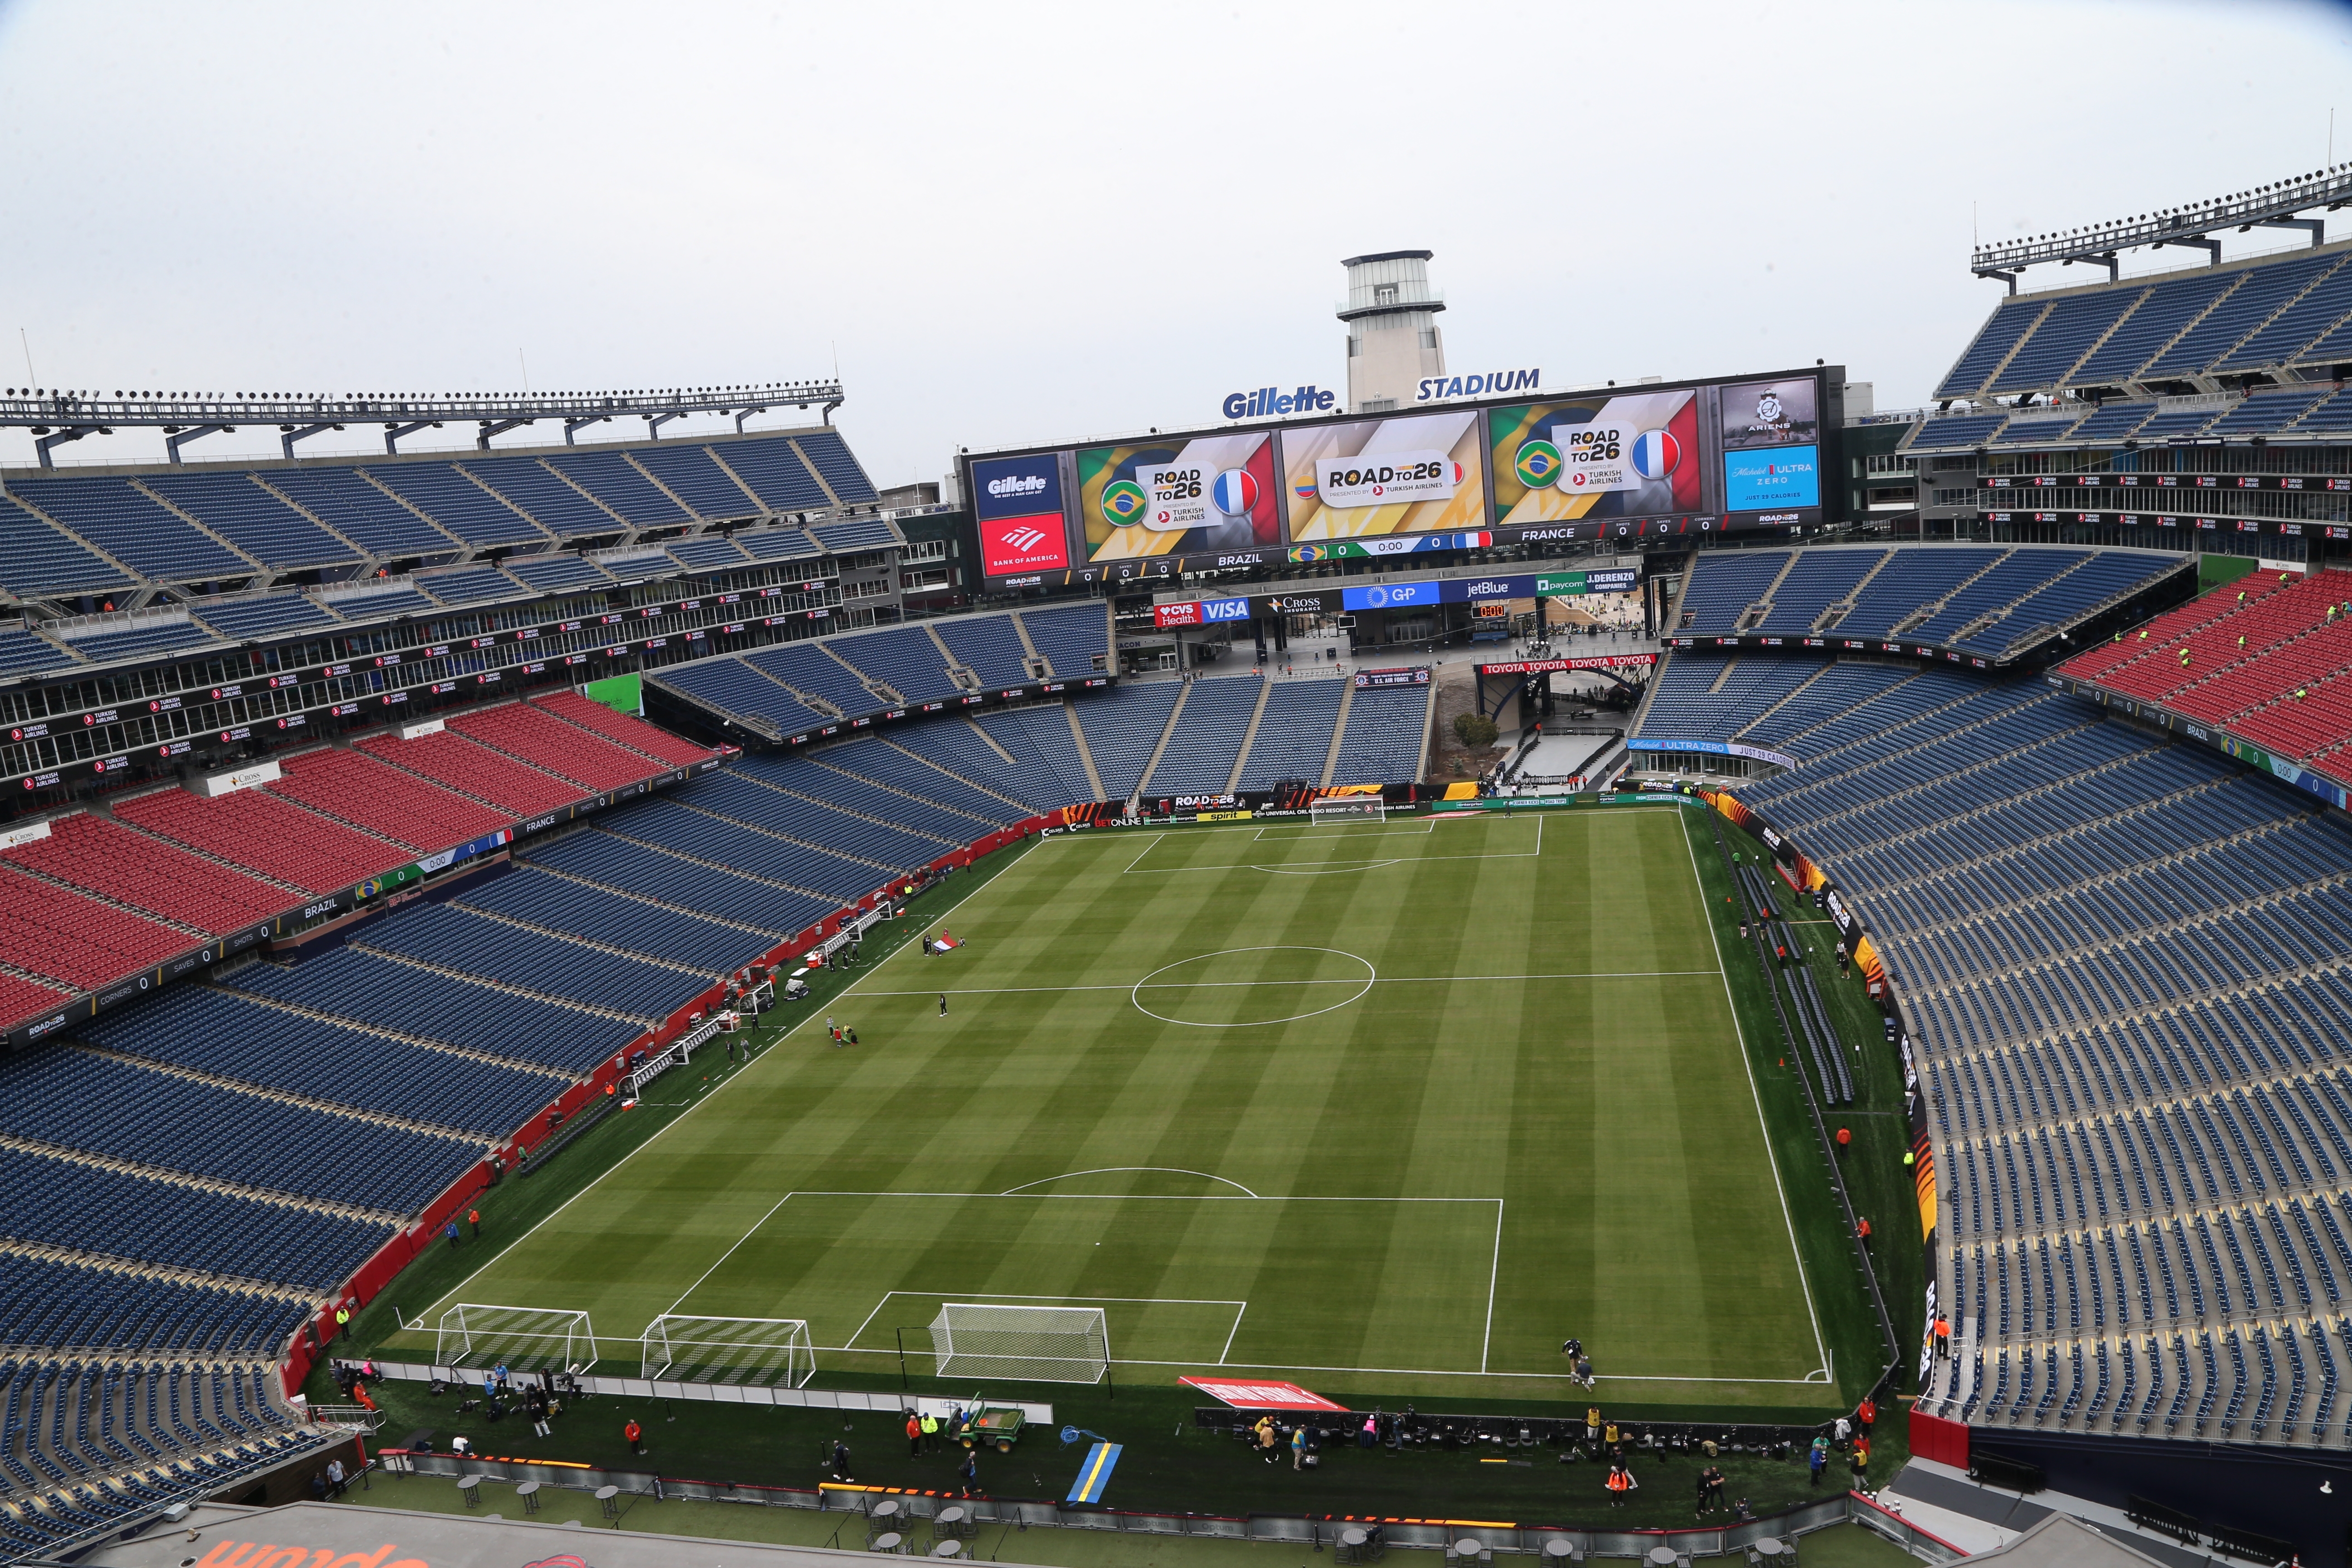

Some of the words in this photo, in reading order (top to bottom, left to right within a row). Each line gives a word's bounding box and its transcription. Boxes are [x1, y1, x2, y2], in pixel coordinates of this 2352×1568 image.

[1223, 385, 1335, 419] Gillette
[1417, 368, 1539, 400] STADIUM
[1748, 423, 1791, 431] ARIENS
[1570, 430, 1619, 445] ROAD
[1571, 452, 1589, 462] TO
[1732, 467, 1767, 477] Michelob
[1777, 464, 1812, 473] ULTRA
[1154, 469, 1200, 485] ROAD
[1329, 467, 1393, 488] ROAD
[1395, 471, 1412, 481] TO
[1589, 477, 1622, 485] AIRLINES
[988, 476, 1046, 494] Gillette
[1155, 491, 1172, 501] TO
[1173, 507, 1204, 515] TURKISH
[1174, 514, 1205, 522] AIRLINES
[1619, 526, 1627, 535] 0
[1660, 524, 1667, 533] 0
[1702, 521, 1710, 530] 0
[1522, 528, 1574, 540] FRANCE
[1338, 545, 1347, 556] 0
[1378, 541, 1403, 552] 0:00
[1431, 538, 1440, 548] 0
[1026, 554, 1058, 563] AMERICA
[1218, 554, 1263, 566] BRAZIL
[1122, 569, 1129, 577] 0
[1587, 572, 1634, 583] J.DERENZO
[1467, 582, 1508, 598] jetBlue
[1550, 582, 1583, 590] paycom
[1171, 605, 1194, 615] CVS
[1203, 601, 1248, 619] VISA
[1481, 606, 1504, 617] 0:00
[1486, 663, 1524, 673] TOYOTA
[1528, 661, 1567, 671] TOYOTA
[1570, 658, 1608, 668] TOYOTA
[1612, 655, 1651, 665] TOYOTA
[2077, 687, 2092, 696] CORNERS
[2095, 691, 2100, 701] 0
[2113, 698, 2123, 707] SAVES
[2127, 702, 2131, 712] 0
[2144, 710, 2156, 719] SHOTS
[2160, 715, 2165, 724] 0
[23, 724, 47, 732] TURKISH
[25, 729, 48, 738] AIRLINES
[2187, 724, 2208, 741] BRAZIL
[1629, 740, 1660, 749] Michelob
[1700, 743, 1724, 751] ZERO
[105, 756, 127, 764] TURKISH
[1740, 747, 1756, 757] JUST
[1768, 754, 1793, 769] CALORIES
[107, 761, 128, 770] AIRLINES
[2254, 752, 2258, 764] 0
[2278, 764, 2291, 778] 0:00
[2313, 779, 2318, 791] 0
[657, 776, 675, 785] CORNERS
[677, 772, 682, 780] 0
[639, 784, 644, 793] 0
[581, 803, 594, 812] SHOTS
[600, 798, 605, 807] 0
[1176, 795, 1210, 806] ROAD
[1210, 812, 1238, 820] spirit
[526, 816, 555, 832] FRANCE
[1095, 818, 1142, 827] BETONLINE
[398, 871, 405, 881] 0
[430, 856, 446, 869] 0:00
[469, 844, 475, 853] 0
[305, 898, 338, 919] BRAZIL
[234, 933, 253, 947] SHOTS
[261, 926, 269, 937] 0
[174, 960, 194, 972] SAVES
[202, 951, 211, 962] 0
[101, 985, 132, 1005] CORNERS
[140, 977, 148, 989] 0
[29, 1021, 50, 1036] ROAD
[782, 1494, 809, 1503] Optum
[1075, 1514, 1106, 1524] Optum
[1137, 1519, 1169, 1529] Optum
[1867, 1509, 1897, 1531] Optum
[1201, 1522, 1234, 1533] Optum
[1401, 1530, 1434, 1541] Optum
